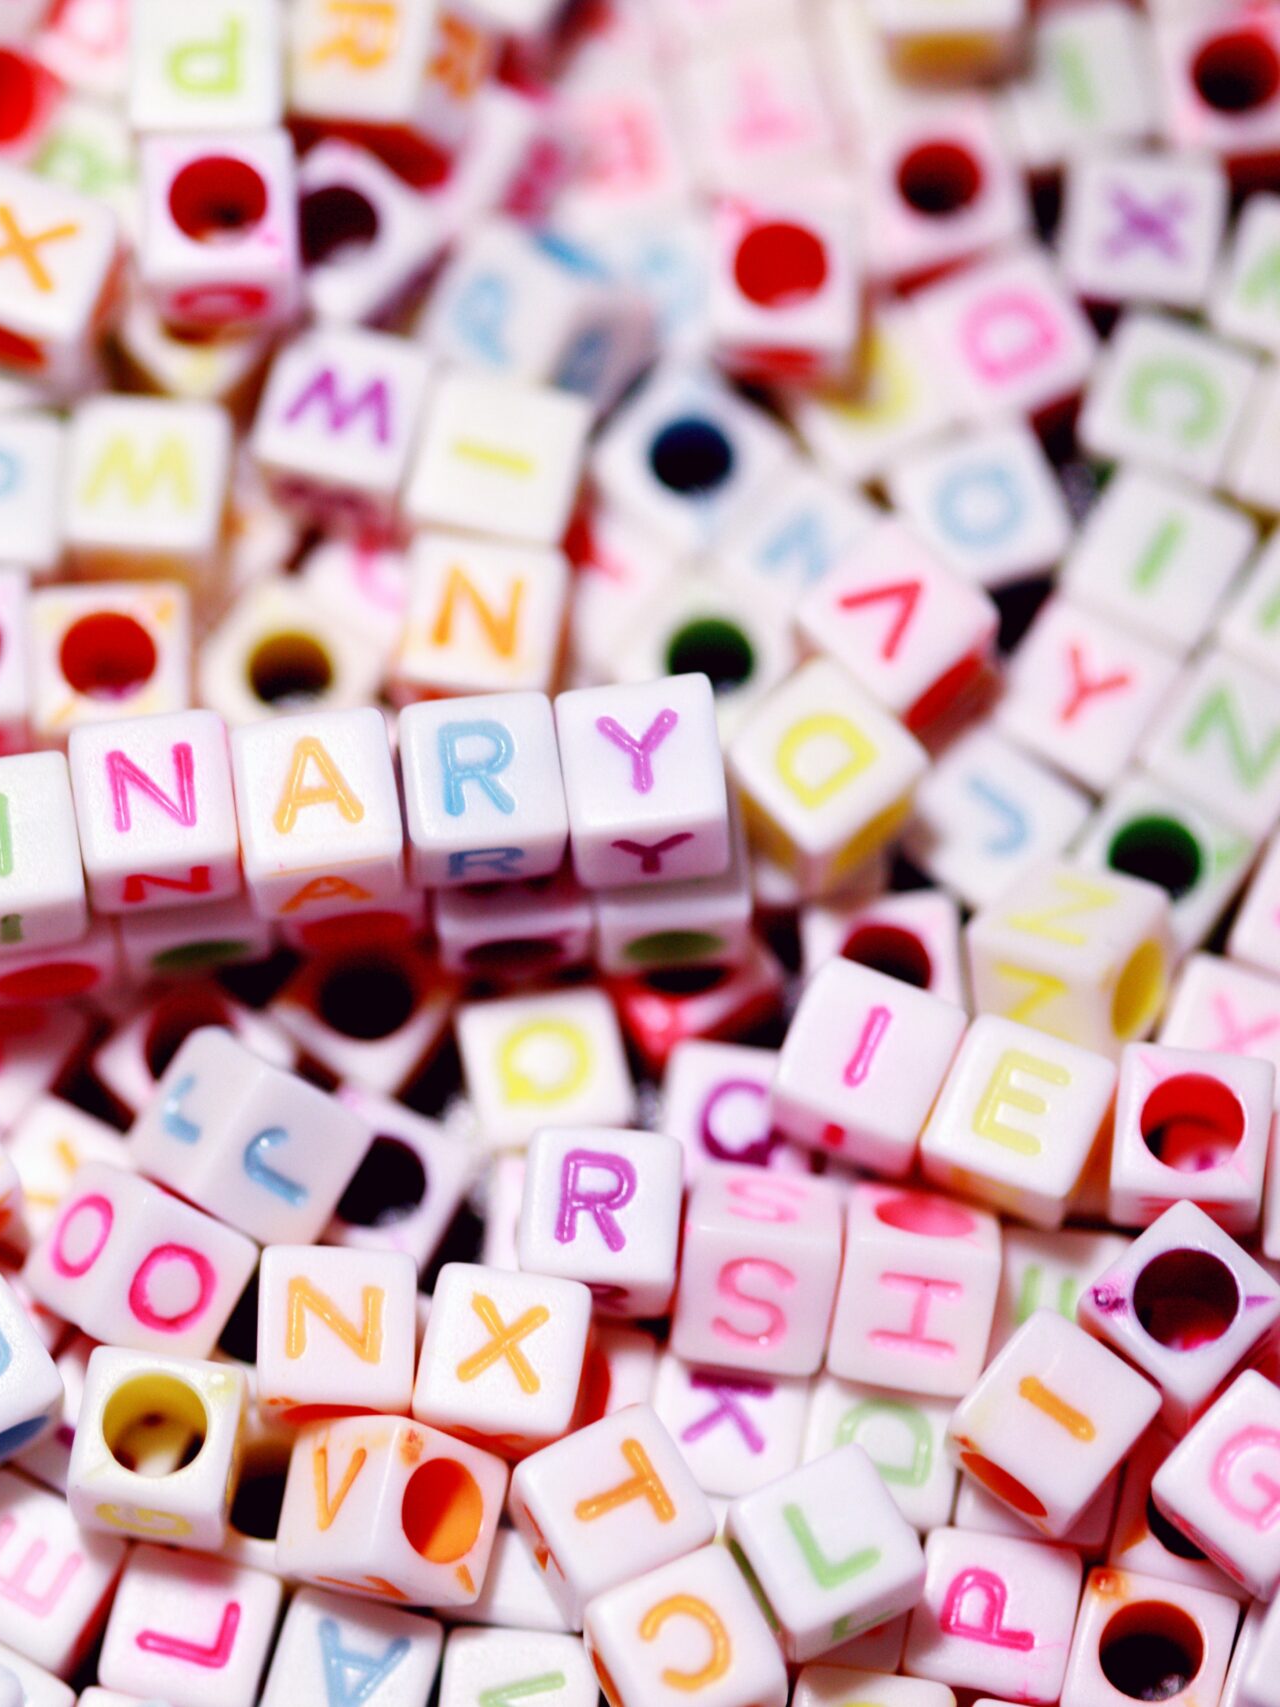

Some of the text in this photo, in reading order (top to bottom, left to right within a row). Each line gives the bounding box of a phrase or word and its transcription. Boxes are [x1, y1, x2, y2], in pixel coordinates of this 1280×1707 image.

[165, 14, 242, 97] P
[1100, 180, 1192, 266] X
[1124, 352, 1226, 448] C
[428, 562, 526, 662] N
[836, 576, 928, 664] V
[1054, 636, 1132, 730] Y
[774, 710, 882, 812] D
[842, 1004, 894, 1088] I
[970, 1046, 1072, 1158] E
[50, 1194, 115, 1279] O
[554, 1146, 638, 1254] R
[127, 1241, 218, 1334] O
[712, 1256, 798, 1351] S
[456, 1290, 550, 1396] X
[680, 1370, 776, 1456] K
[313, 1443, 368, 1533] V
[575, 1436, 678, 1524] T
[1209, 1422, 1280, 1533] G
[780, 1502, 884, 1590] L
[135, 1599, 242, 1670] L
[638, 1592, 732, 1692] C
[938, 1565, 1036, 1652] P
[318, 1616, 414, 1707] A
